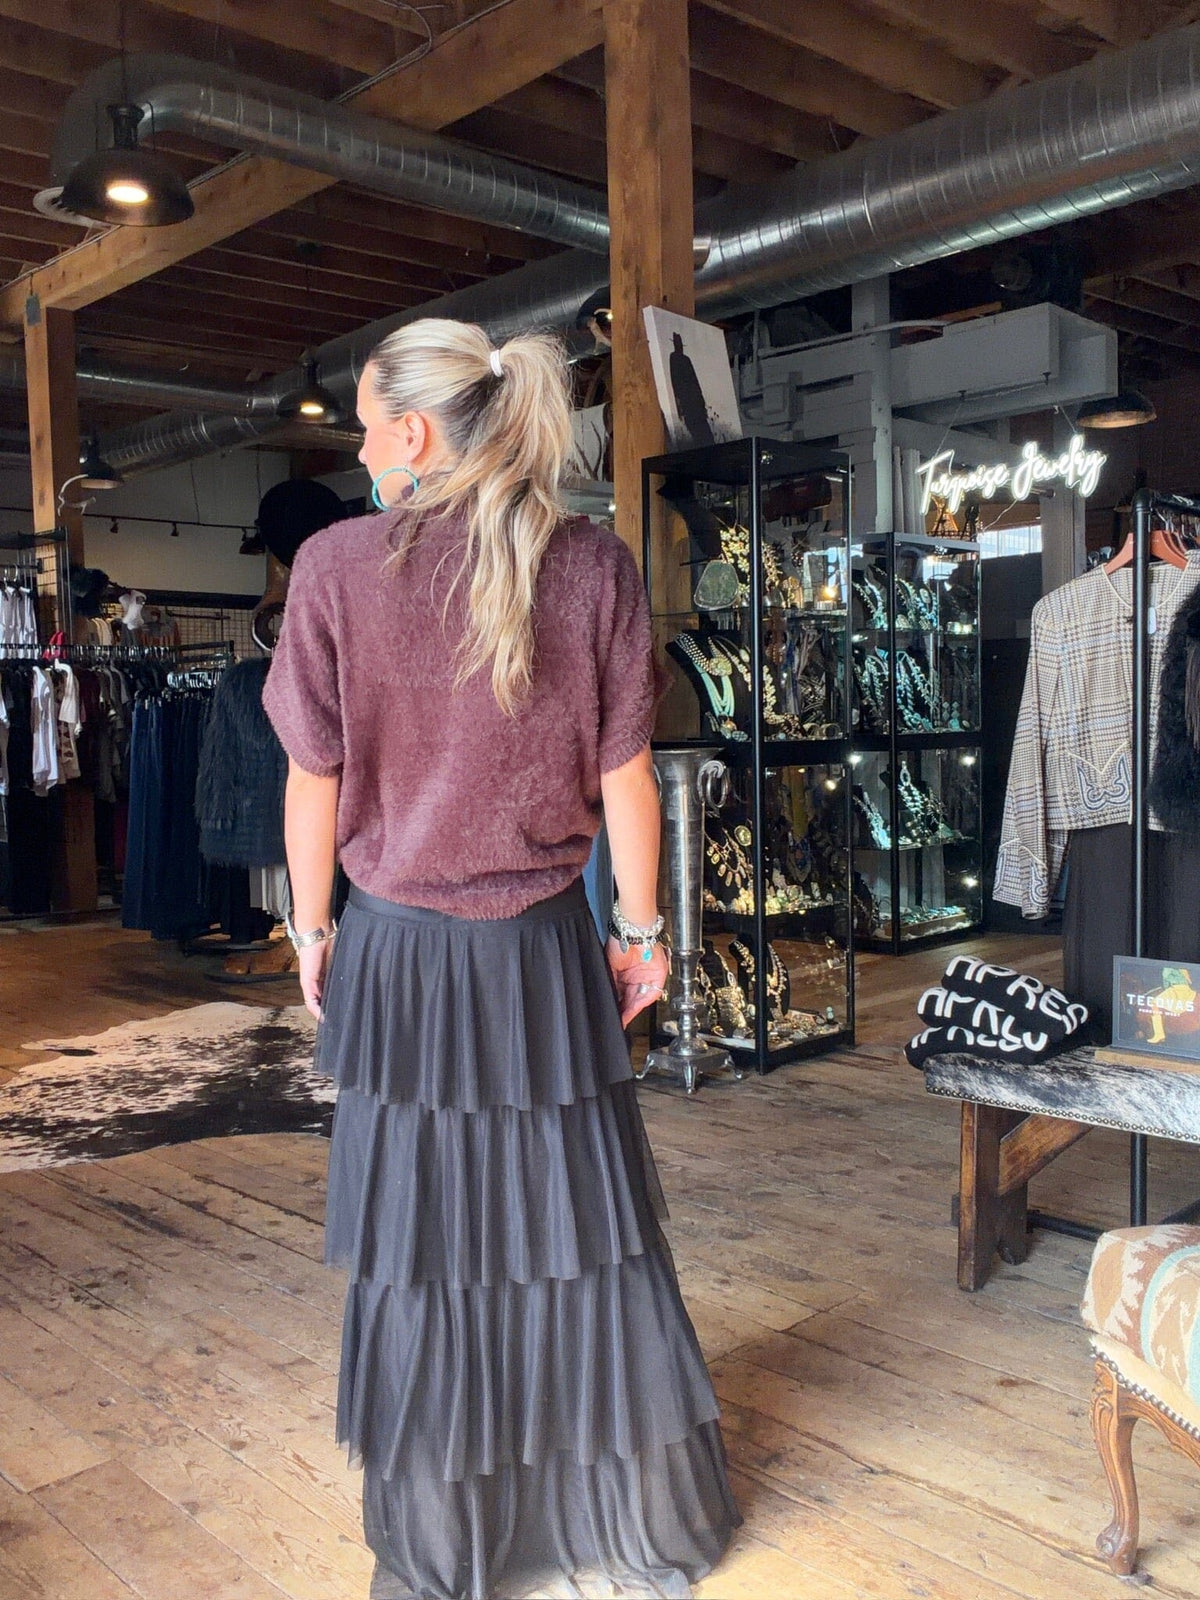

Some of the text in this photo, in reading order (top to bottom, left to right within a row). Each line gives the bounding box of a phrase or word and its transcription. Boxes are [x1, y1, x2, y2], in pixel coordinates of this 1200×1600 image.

[915, 434, 1107, 514] Turquoise Jewelry
[1126, 993, 1194, 1012] TECOVAS
